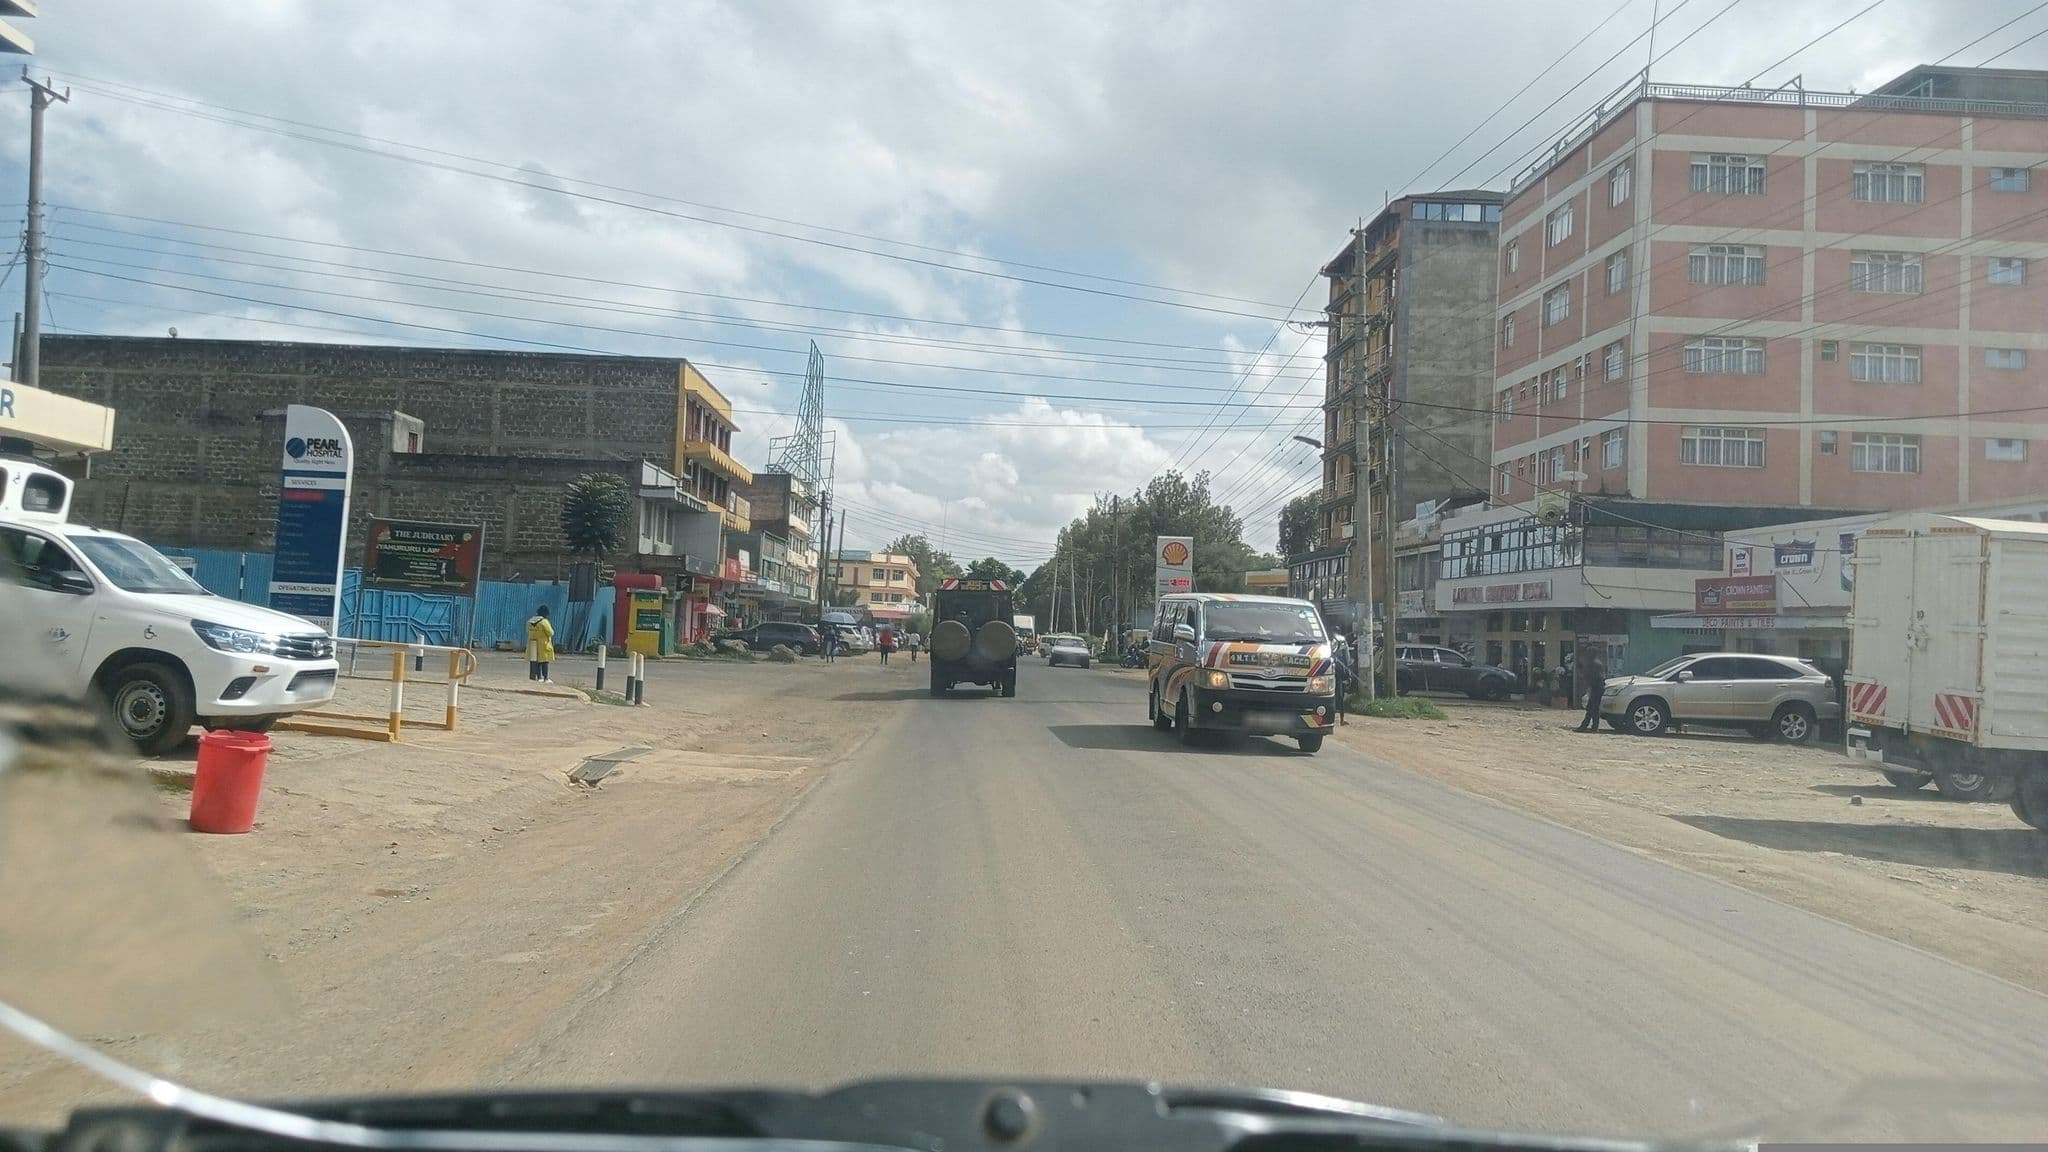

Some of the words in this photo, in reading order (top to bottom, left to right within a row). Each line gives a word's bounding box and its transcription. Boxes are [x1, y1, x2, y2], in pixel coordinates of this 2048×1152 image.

[306, 438, 342, 451] PEARL
[306, 449, 342, 459] HOSPITAL
[395, 530, 410, 538] THE
[412, 531, 455, 541] JUDICIARY
[1780, 553, 1808, 565] crown
[278, 584, 310, 592] OPERATING
[1283, 656, 1310, 666] SACCO
